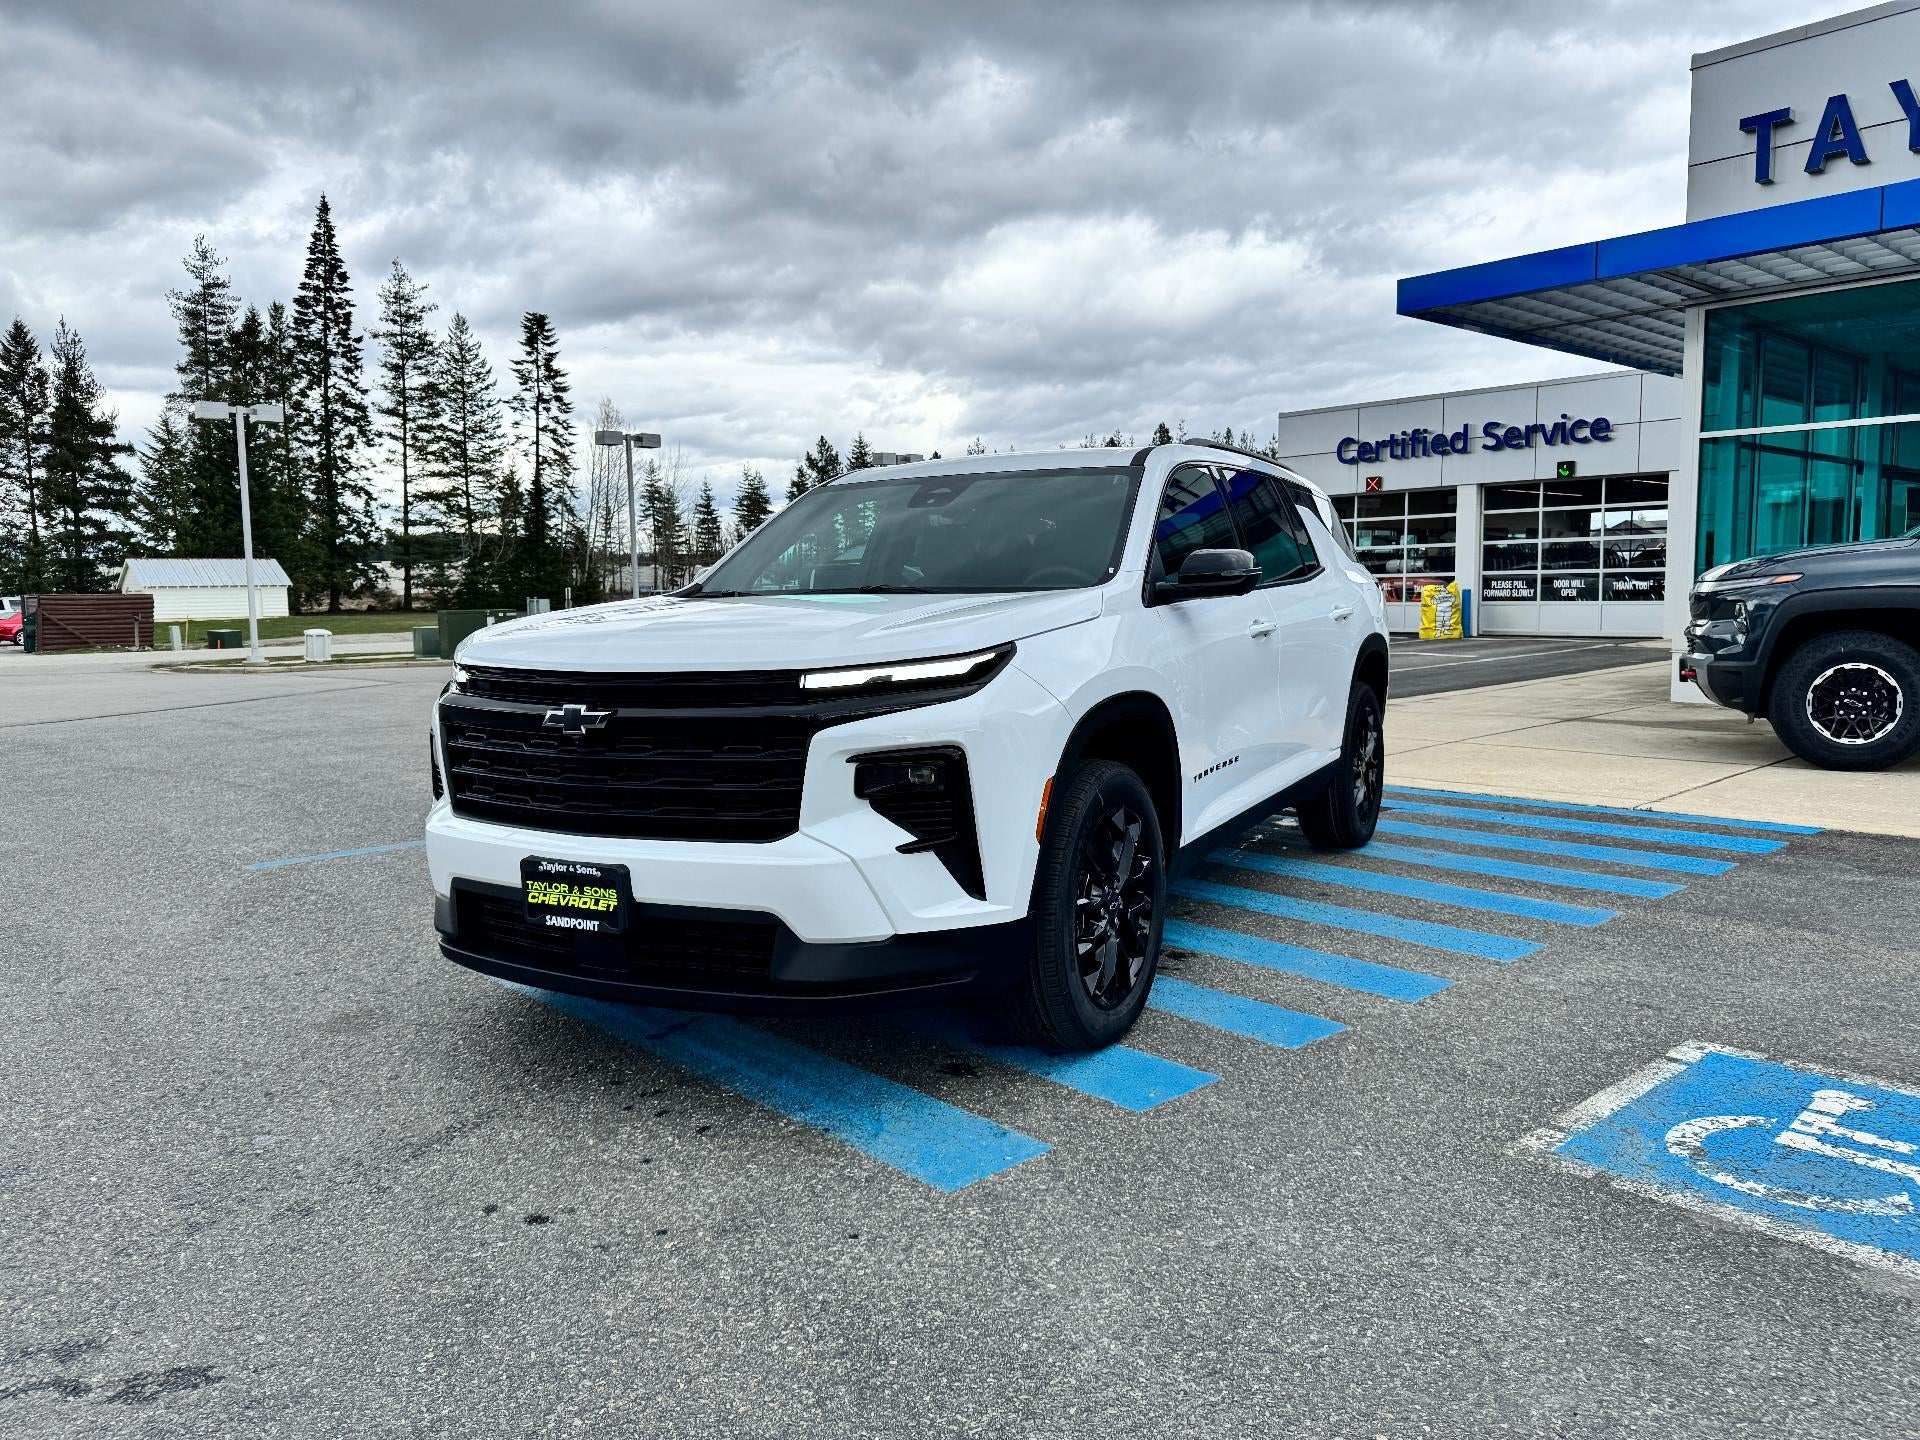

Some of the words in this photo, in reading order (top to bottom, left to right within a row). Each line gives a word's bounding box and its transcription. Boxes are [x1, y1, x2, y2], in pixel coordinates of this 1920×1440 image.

[1336, 424, 1470, 465] Certified
[1482, 414, 1612, 451] Service
[1491, 580, 1513, 589] PLEASE
[1513, 580, 1528, 589] PULL
[1553, 579, 1570, 588] DOOR
[1570, 579, 1586, 588] WILL
[1612, 580, 1633, 590] THANK
[1483, 589, 1511, 598] FORWARD
[1511, 589, 1535, 598] SLOWLY
[1560, 588, 1577, 597] OPEN
[1193, 755, 1240, 784] TRAVERSE
[541, 861, 567, 874] Taylor
[568, 864, 575, 872] &
[576, 864, 598, 876] Sons
[526, 881, 569, 893] TAYLOR
[572, 885, 580, 896] &
[583, 886, 617, 899] SONS
[528, 892, 618, 912] CHEVROLET
[545, 914, 600, 932] SANDPOINT
